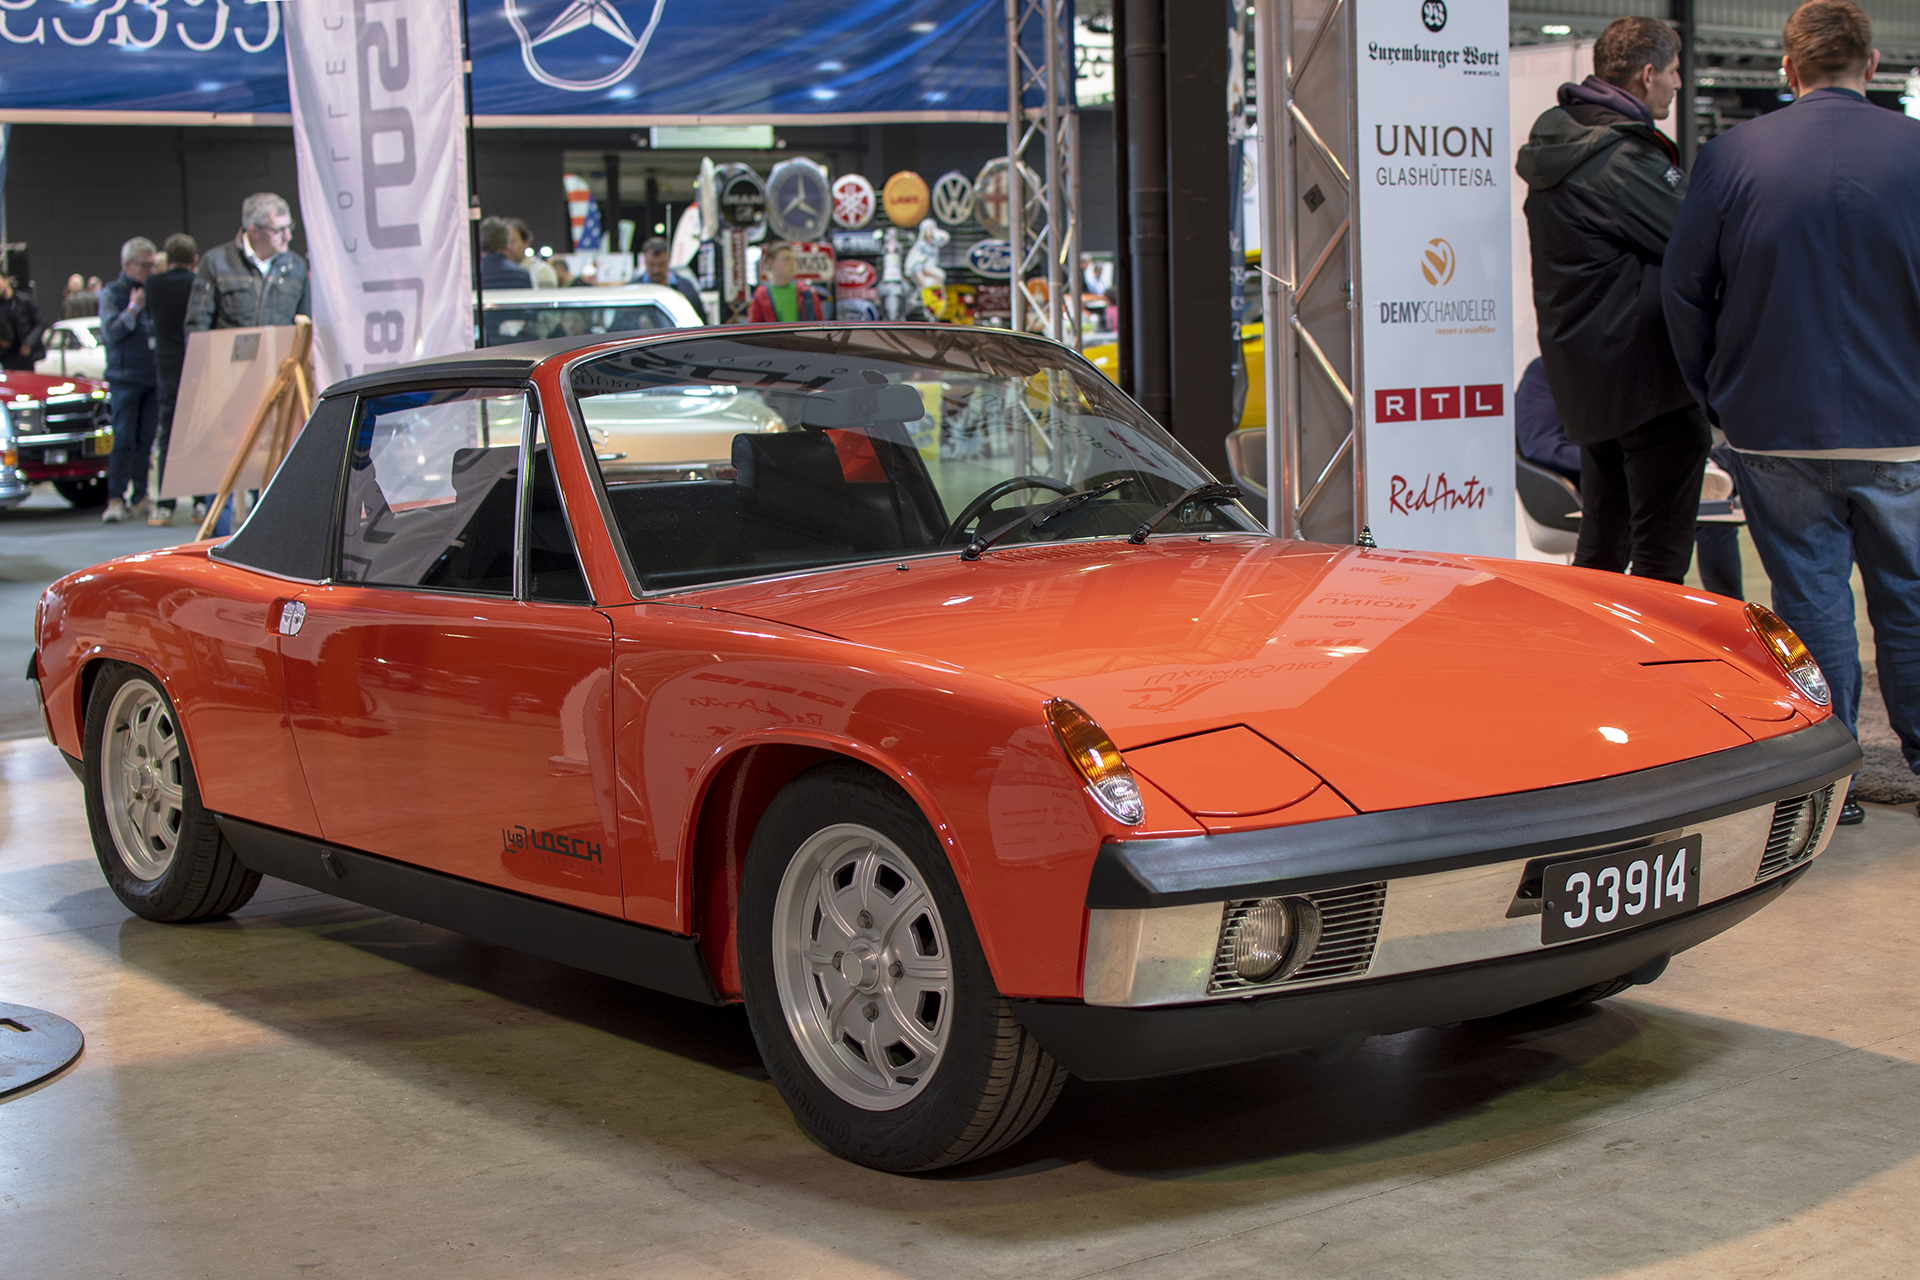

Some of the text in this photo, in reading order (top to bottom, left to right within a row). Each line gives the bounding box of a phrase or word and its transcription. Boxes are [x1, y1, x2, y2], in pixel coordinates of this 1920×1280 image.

[1368, 41, 1500, 69] Luxemburger Wort
[1375, 124, 1493, 158] UNION
[1376, 163, 1497, 187] GLASHÜTTE/SA.
[1435, 327, 1457, 335] reesen
[1381, 387, 1498, 419] RTL
[531, 829, 602, 864] LOSCH
[533, 851, 604, 875] COLLECTION
[1563, 847, 1687, 929] 33914
